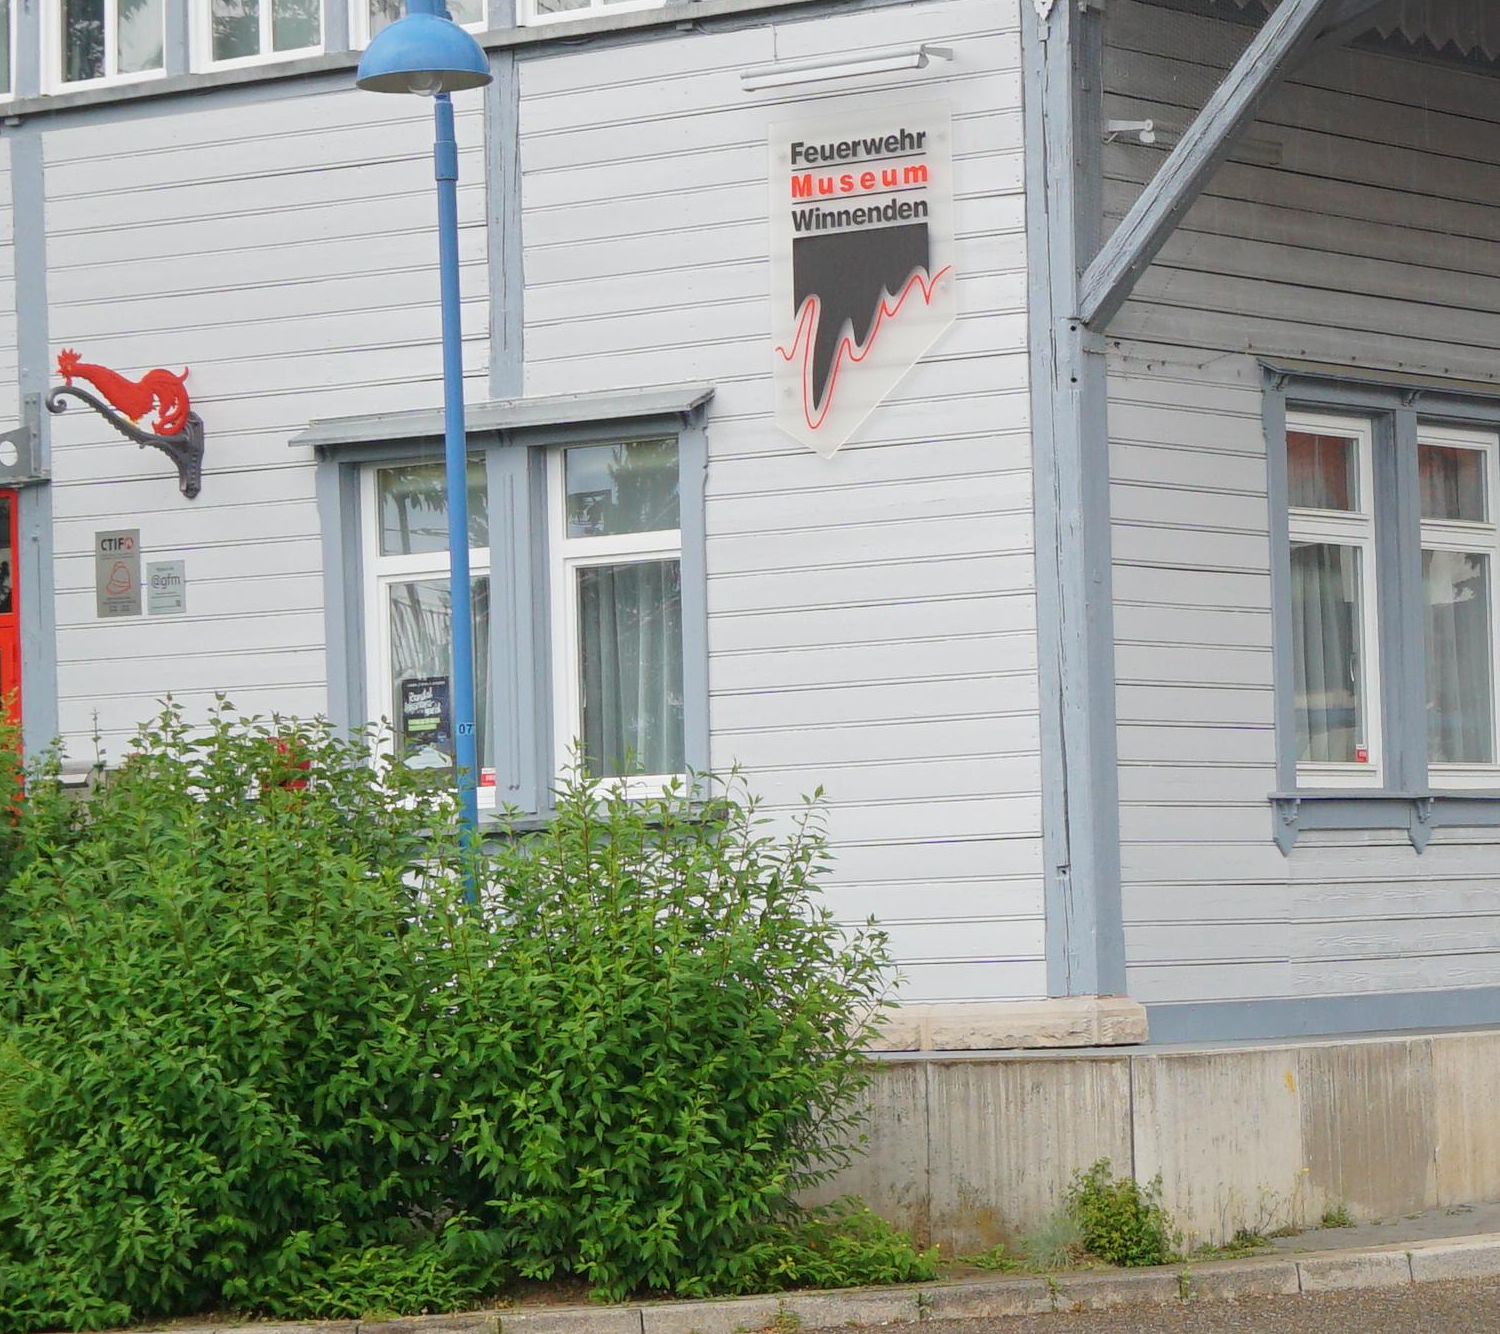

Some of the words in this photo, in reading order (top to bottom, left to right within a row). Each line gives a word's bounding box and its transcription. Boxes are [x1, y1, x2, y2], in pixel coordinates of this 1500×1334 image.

[791, 128, 927, 165] Feuerwehr
[791, 163, 928, 198] Museum
[792, 198, 929, 232] Winnenden
[101, 537, 124, 551] CTIF
[458, 723, 473, 735] 07
